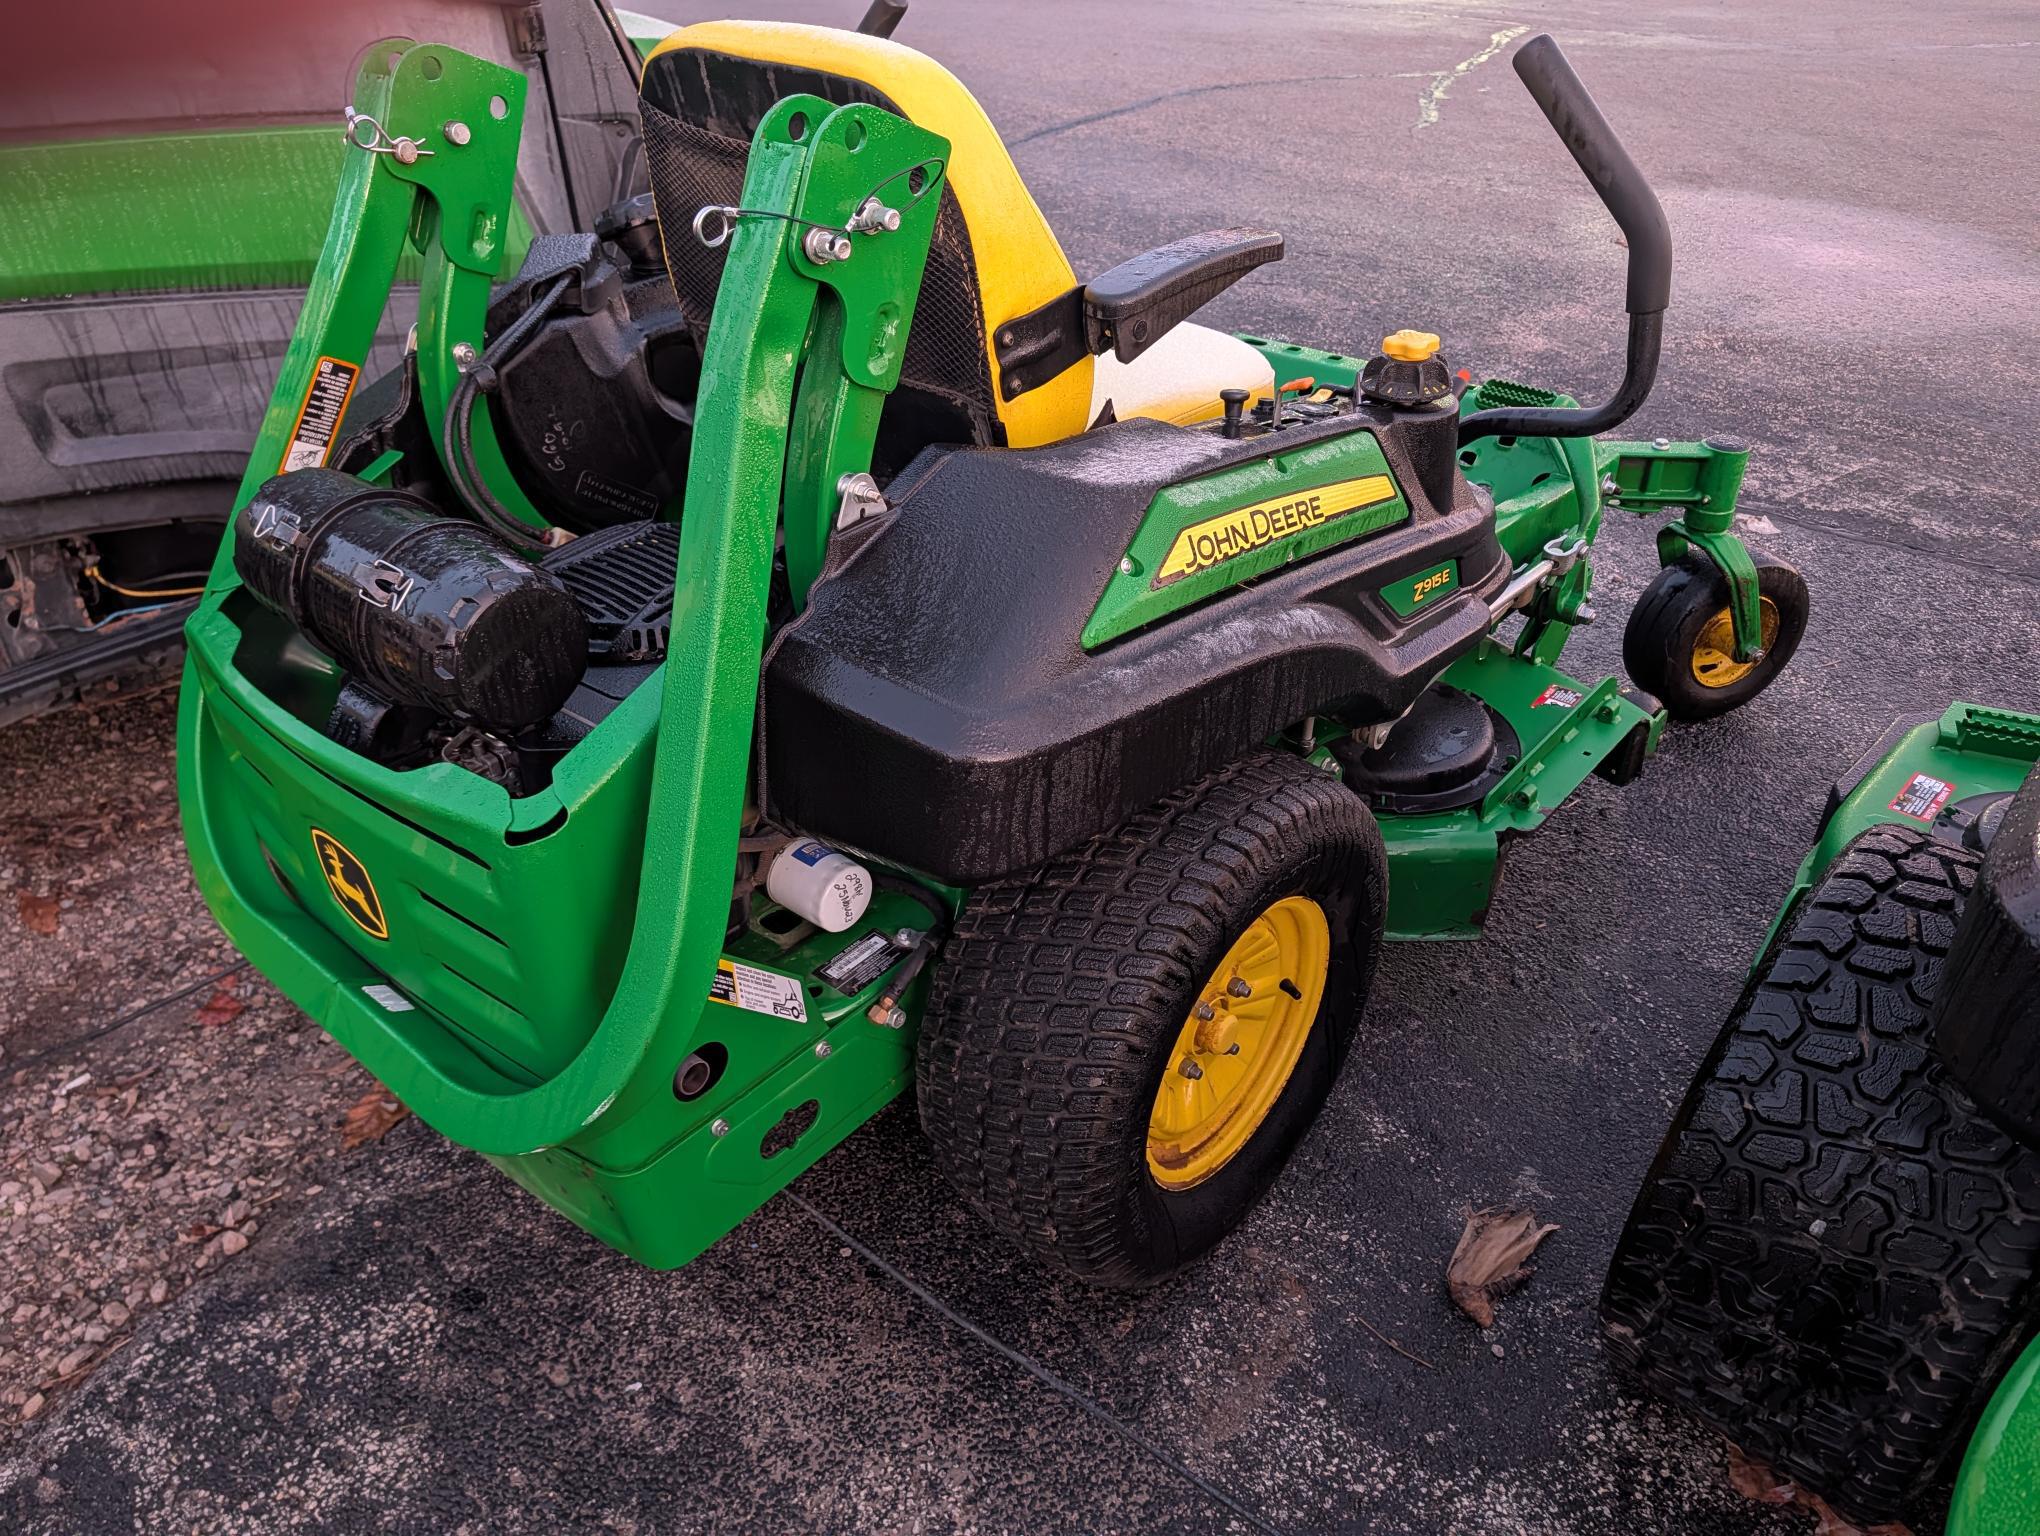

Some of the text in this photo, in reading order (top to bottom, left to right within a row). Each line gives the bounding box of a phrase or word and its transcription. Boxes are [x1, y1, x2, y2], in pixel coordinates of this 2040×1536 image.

[1185, 496, 1325, 568] JOHN DEERE
[1413, 568, 1451, 604] Z915E
